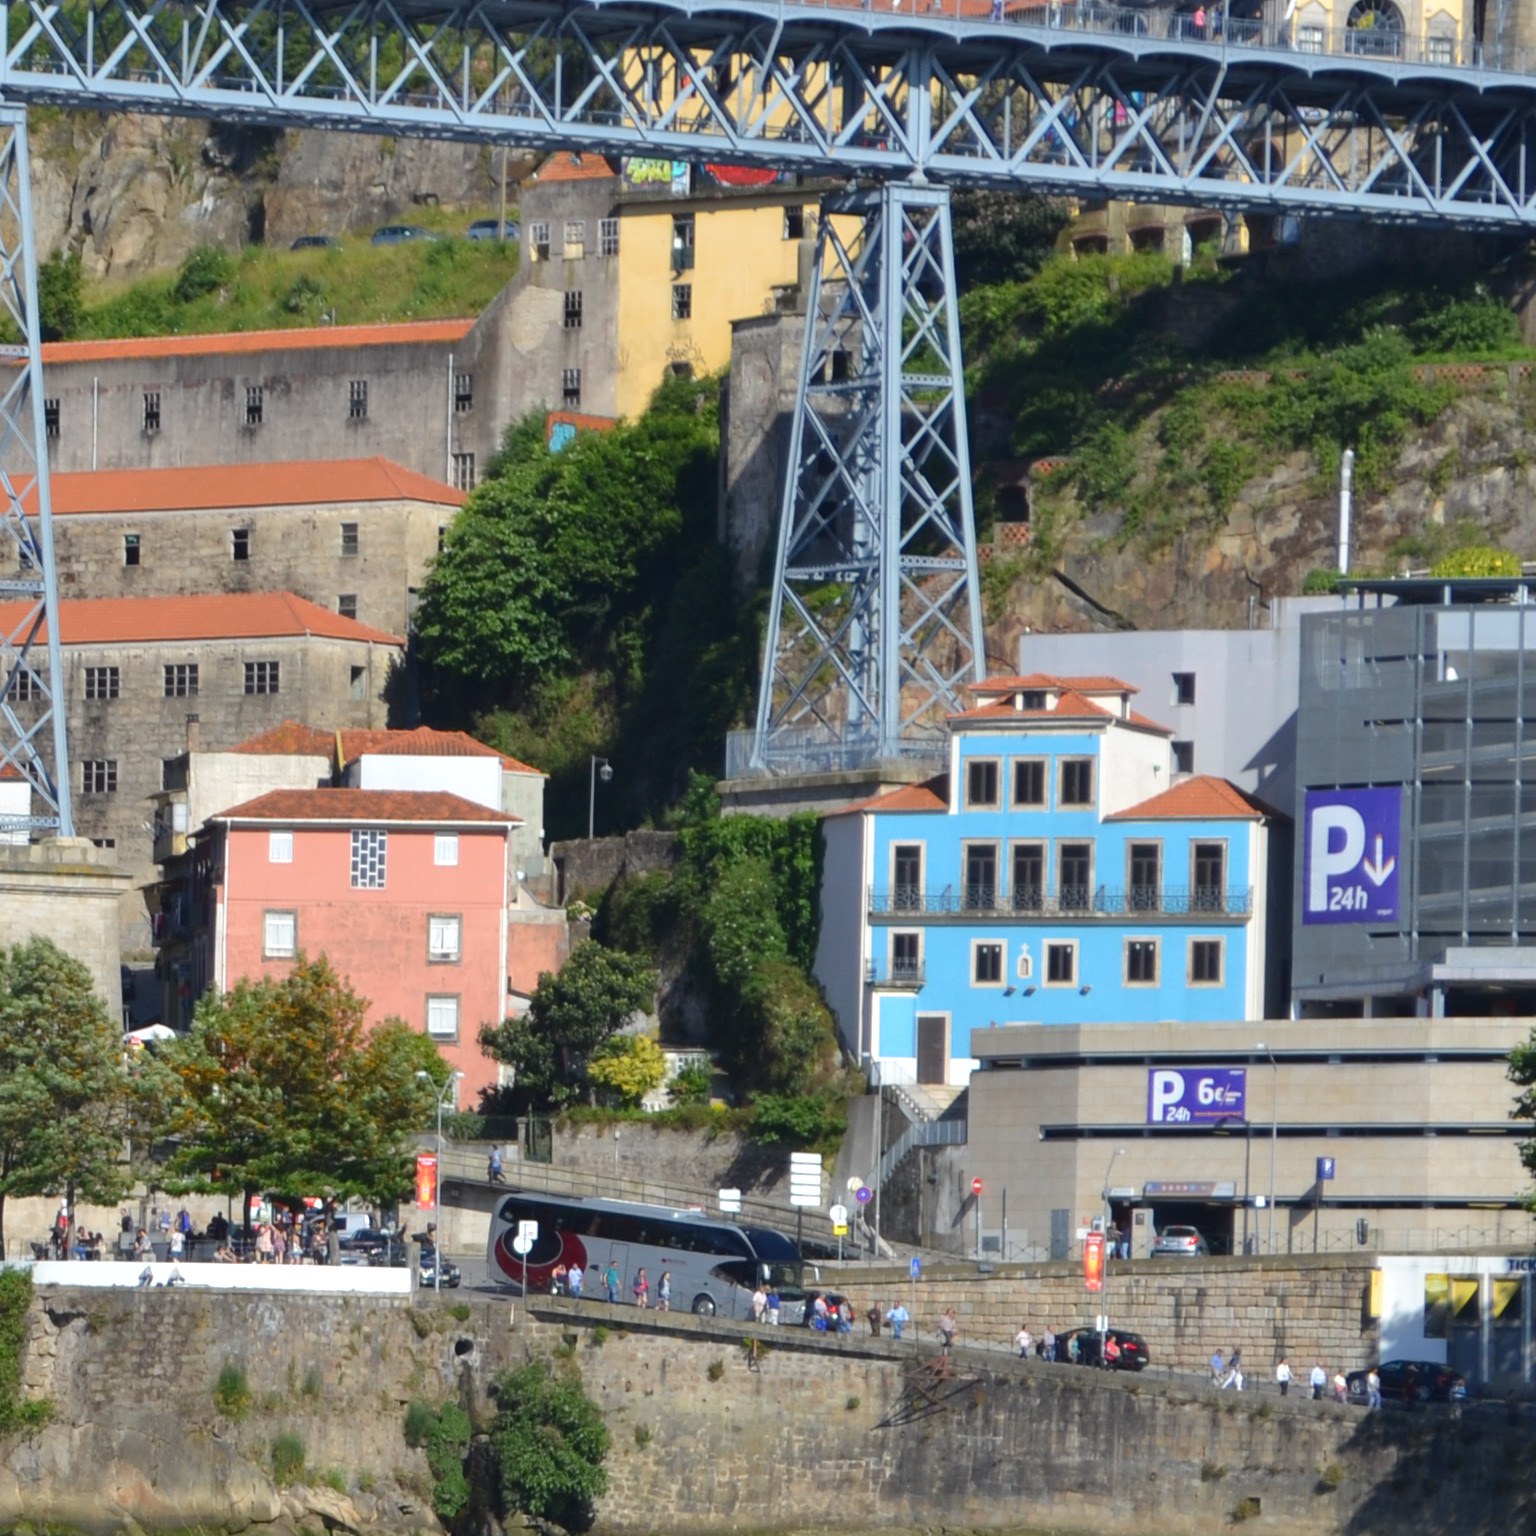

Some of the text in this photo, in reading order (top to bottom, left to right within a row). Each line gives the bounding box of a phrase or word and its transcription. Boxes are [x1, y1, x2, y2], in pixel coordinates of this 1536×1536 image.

[1309, 804, 1366, 912] P
[1329, 885, 1368, 911] 24h
[1152, 1070, 1185, 1121] P
[1166, 1106, 1191, 1122] 24h
